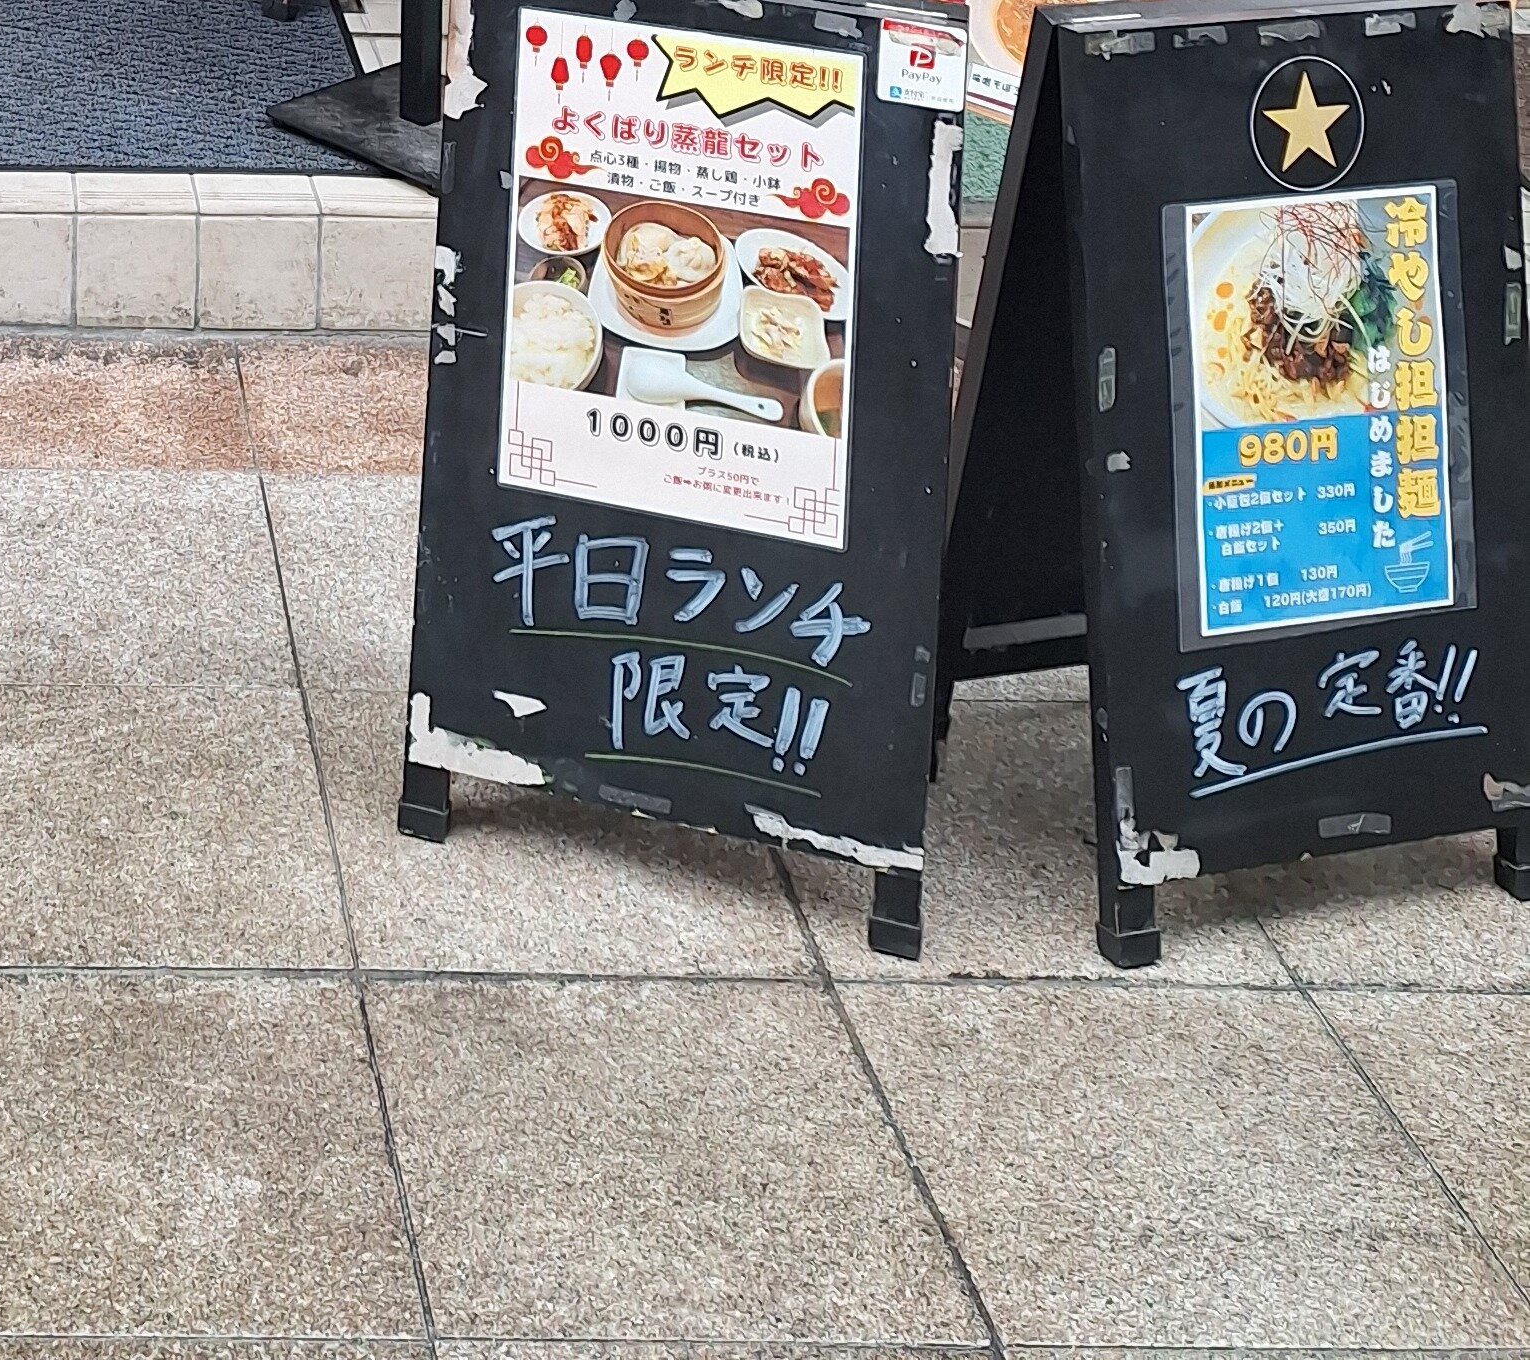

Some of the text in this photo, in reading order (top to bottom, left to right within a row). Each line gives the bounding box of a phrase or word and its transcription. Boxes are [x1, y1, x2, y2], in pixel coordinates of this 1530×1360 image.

[673, 45, 844, 93] ランチ限定!!
[901, 68, 943, 85] PayPay
[551, 106, 825, 172] よくばり蒸龍セット
[1384, 195, 1442, 520] 冷やし担担麺
[587, 407, 724, 461] 1000円
[1238, 425, 1339, 468] 980円
[1367, 345, 1396, 551] はじめました
[1316, 482, 1356, 499] 330円
[1318, 518, 1357, 536] 350円
[491, 514, 872, 667] 平日ランチ
[1300, 564, 1338, 581] 130円
[610, 650, 831, 777] 限定!!
[1177, 639, 1479, 778] 夏の 定番!!
